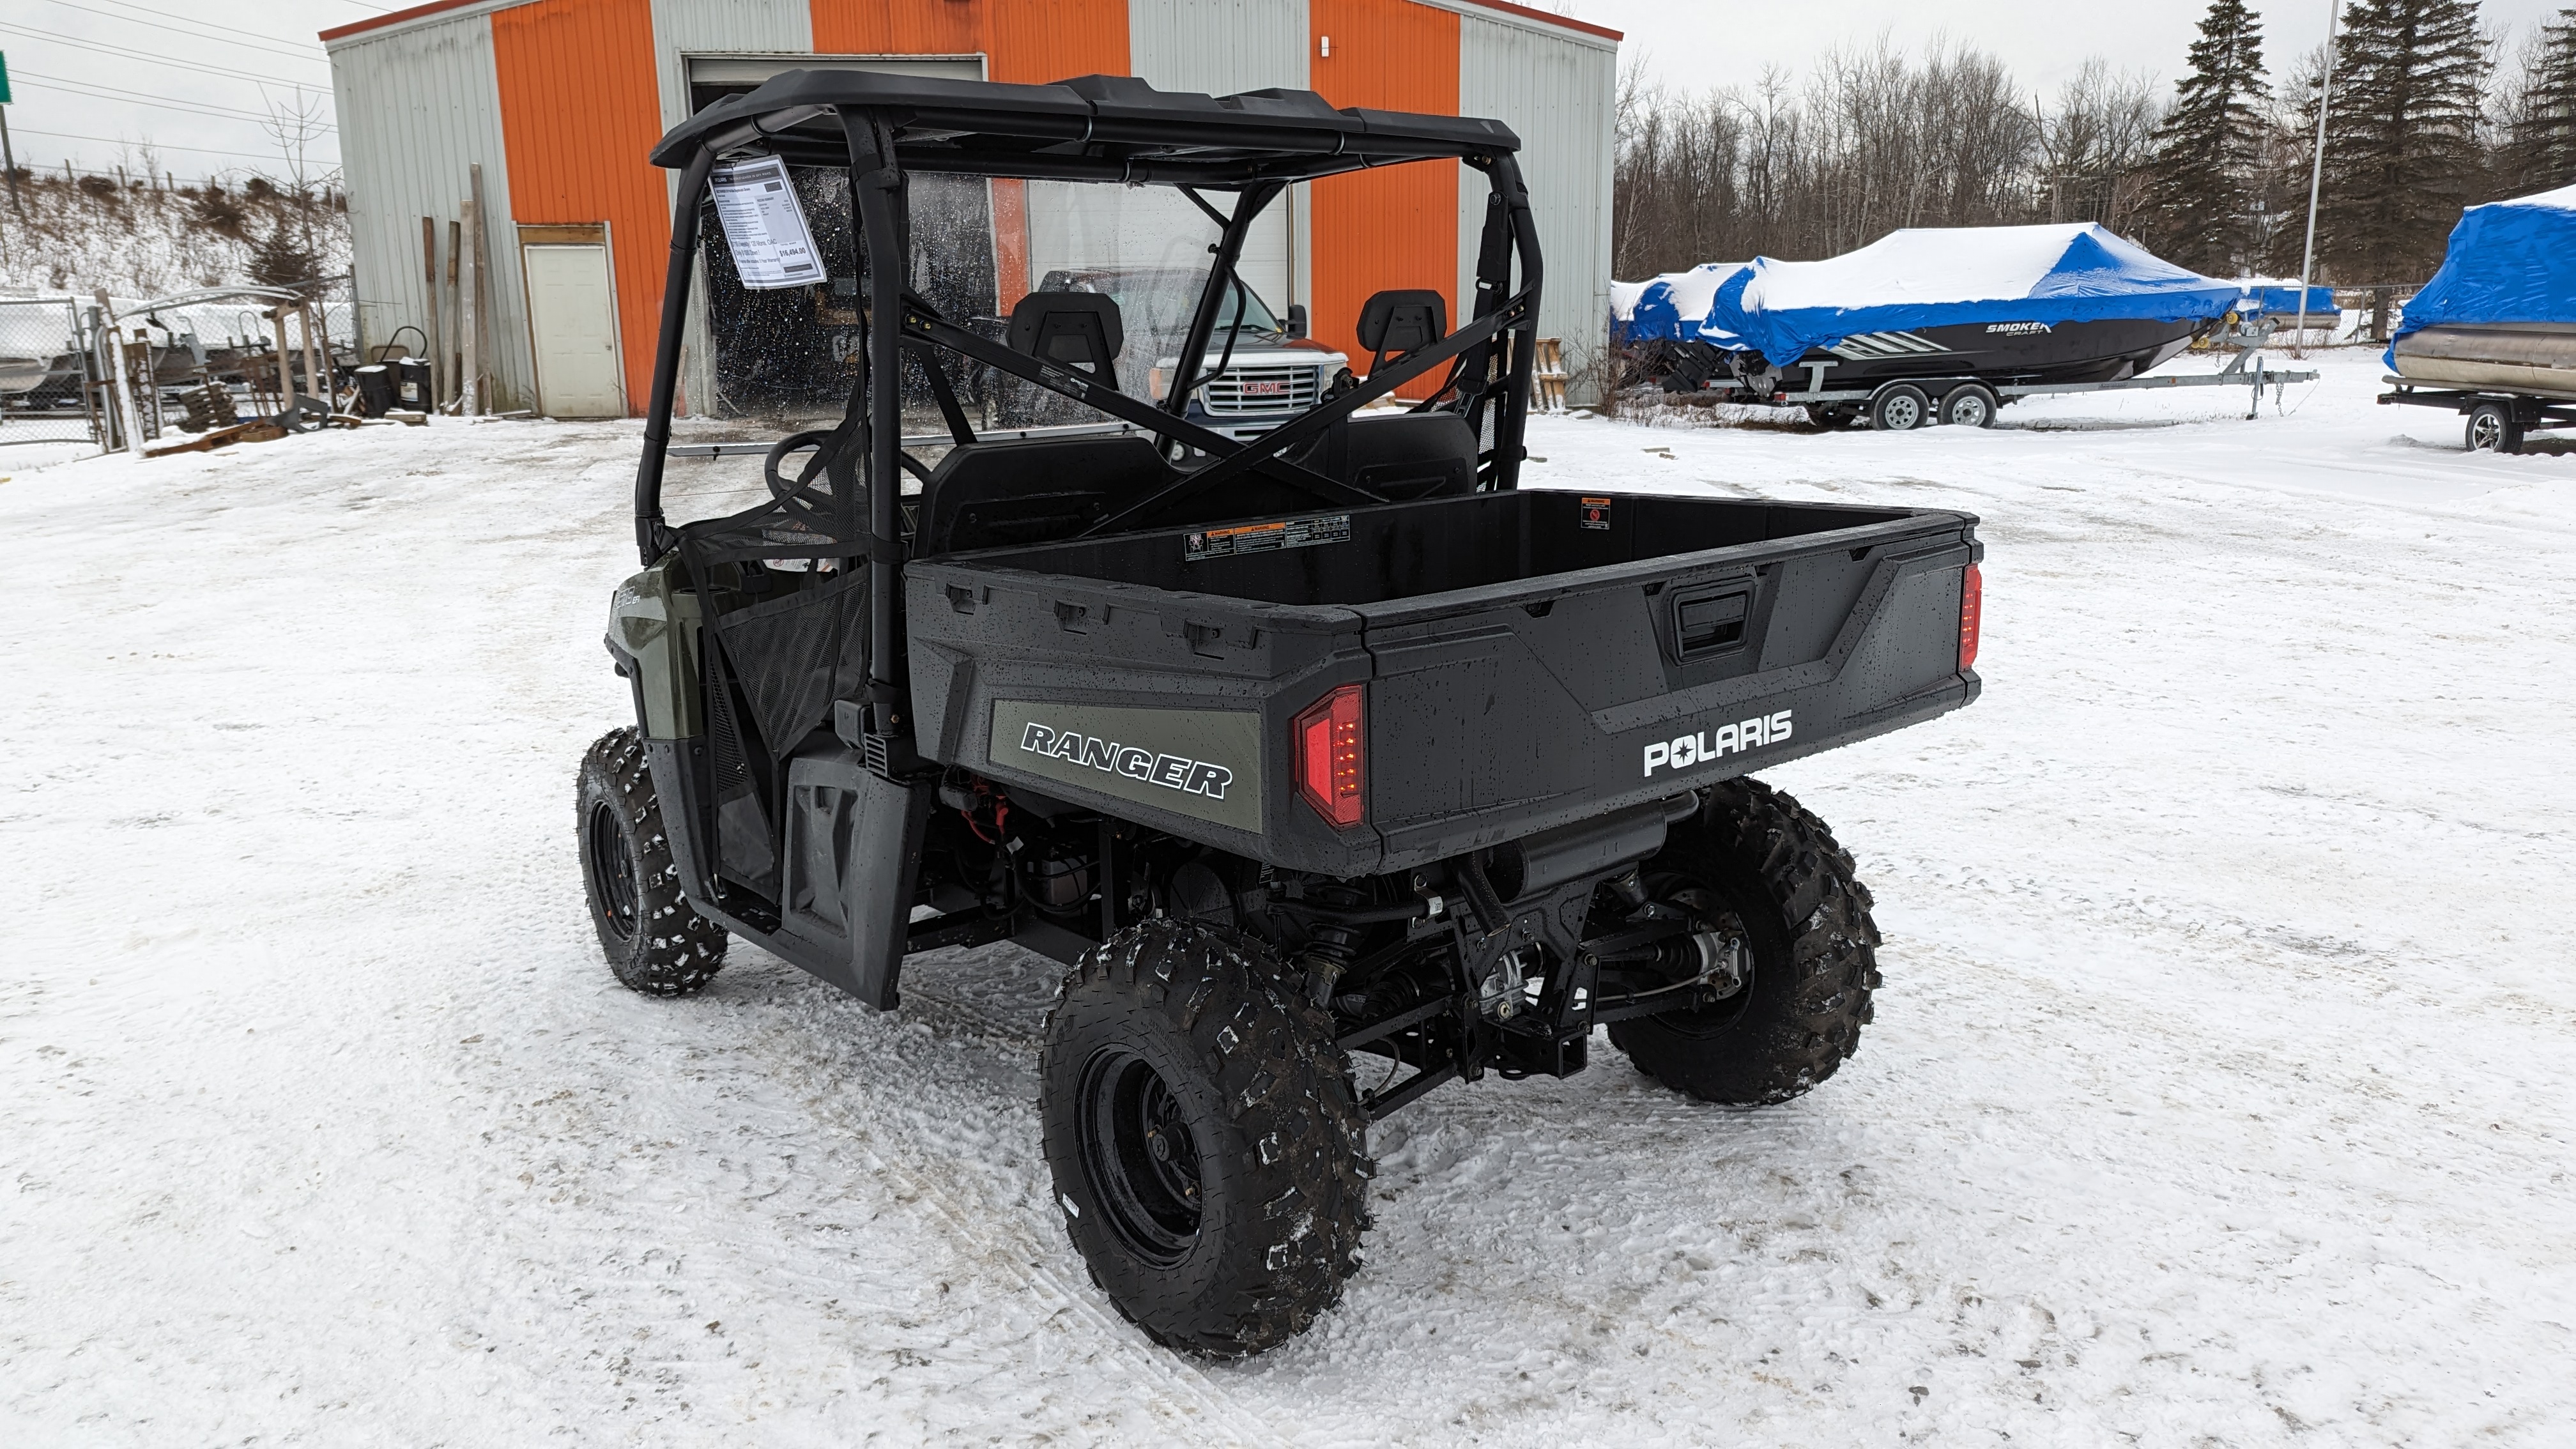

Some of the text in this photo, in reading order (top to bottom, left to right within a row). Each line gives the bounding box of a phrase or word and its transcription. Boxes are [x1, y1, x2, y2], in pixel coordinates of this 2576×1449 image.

[779, 247, 806, 257] $16,494.00
[1243, 381, 1291, 395] GMC
[1020, 722, 1232, 800] RANGER
[1644, 709, 1792, 778] POLARIS
